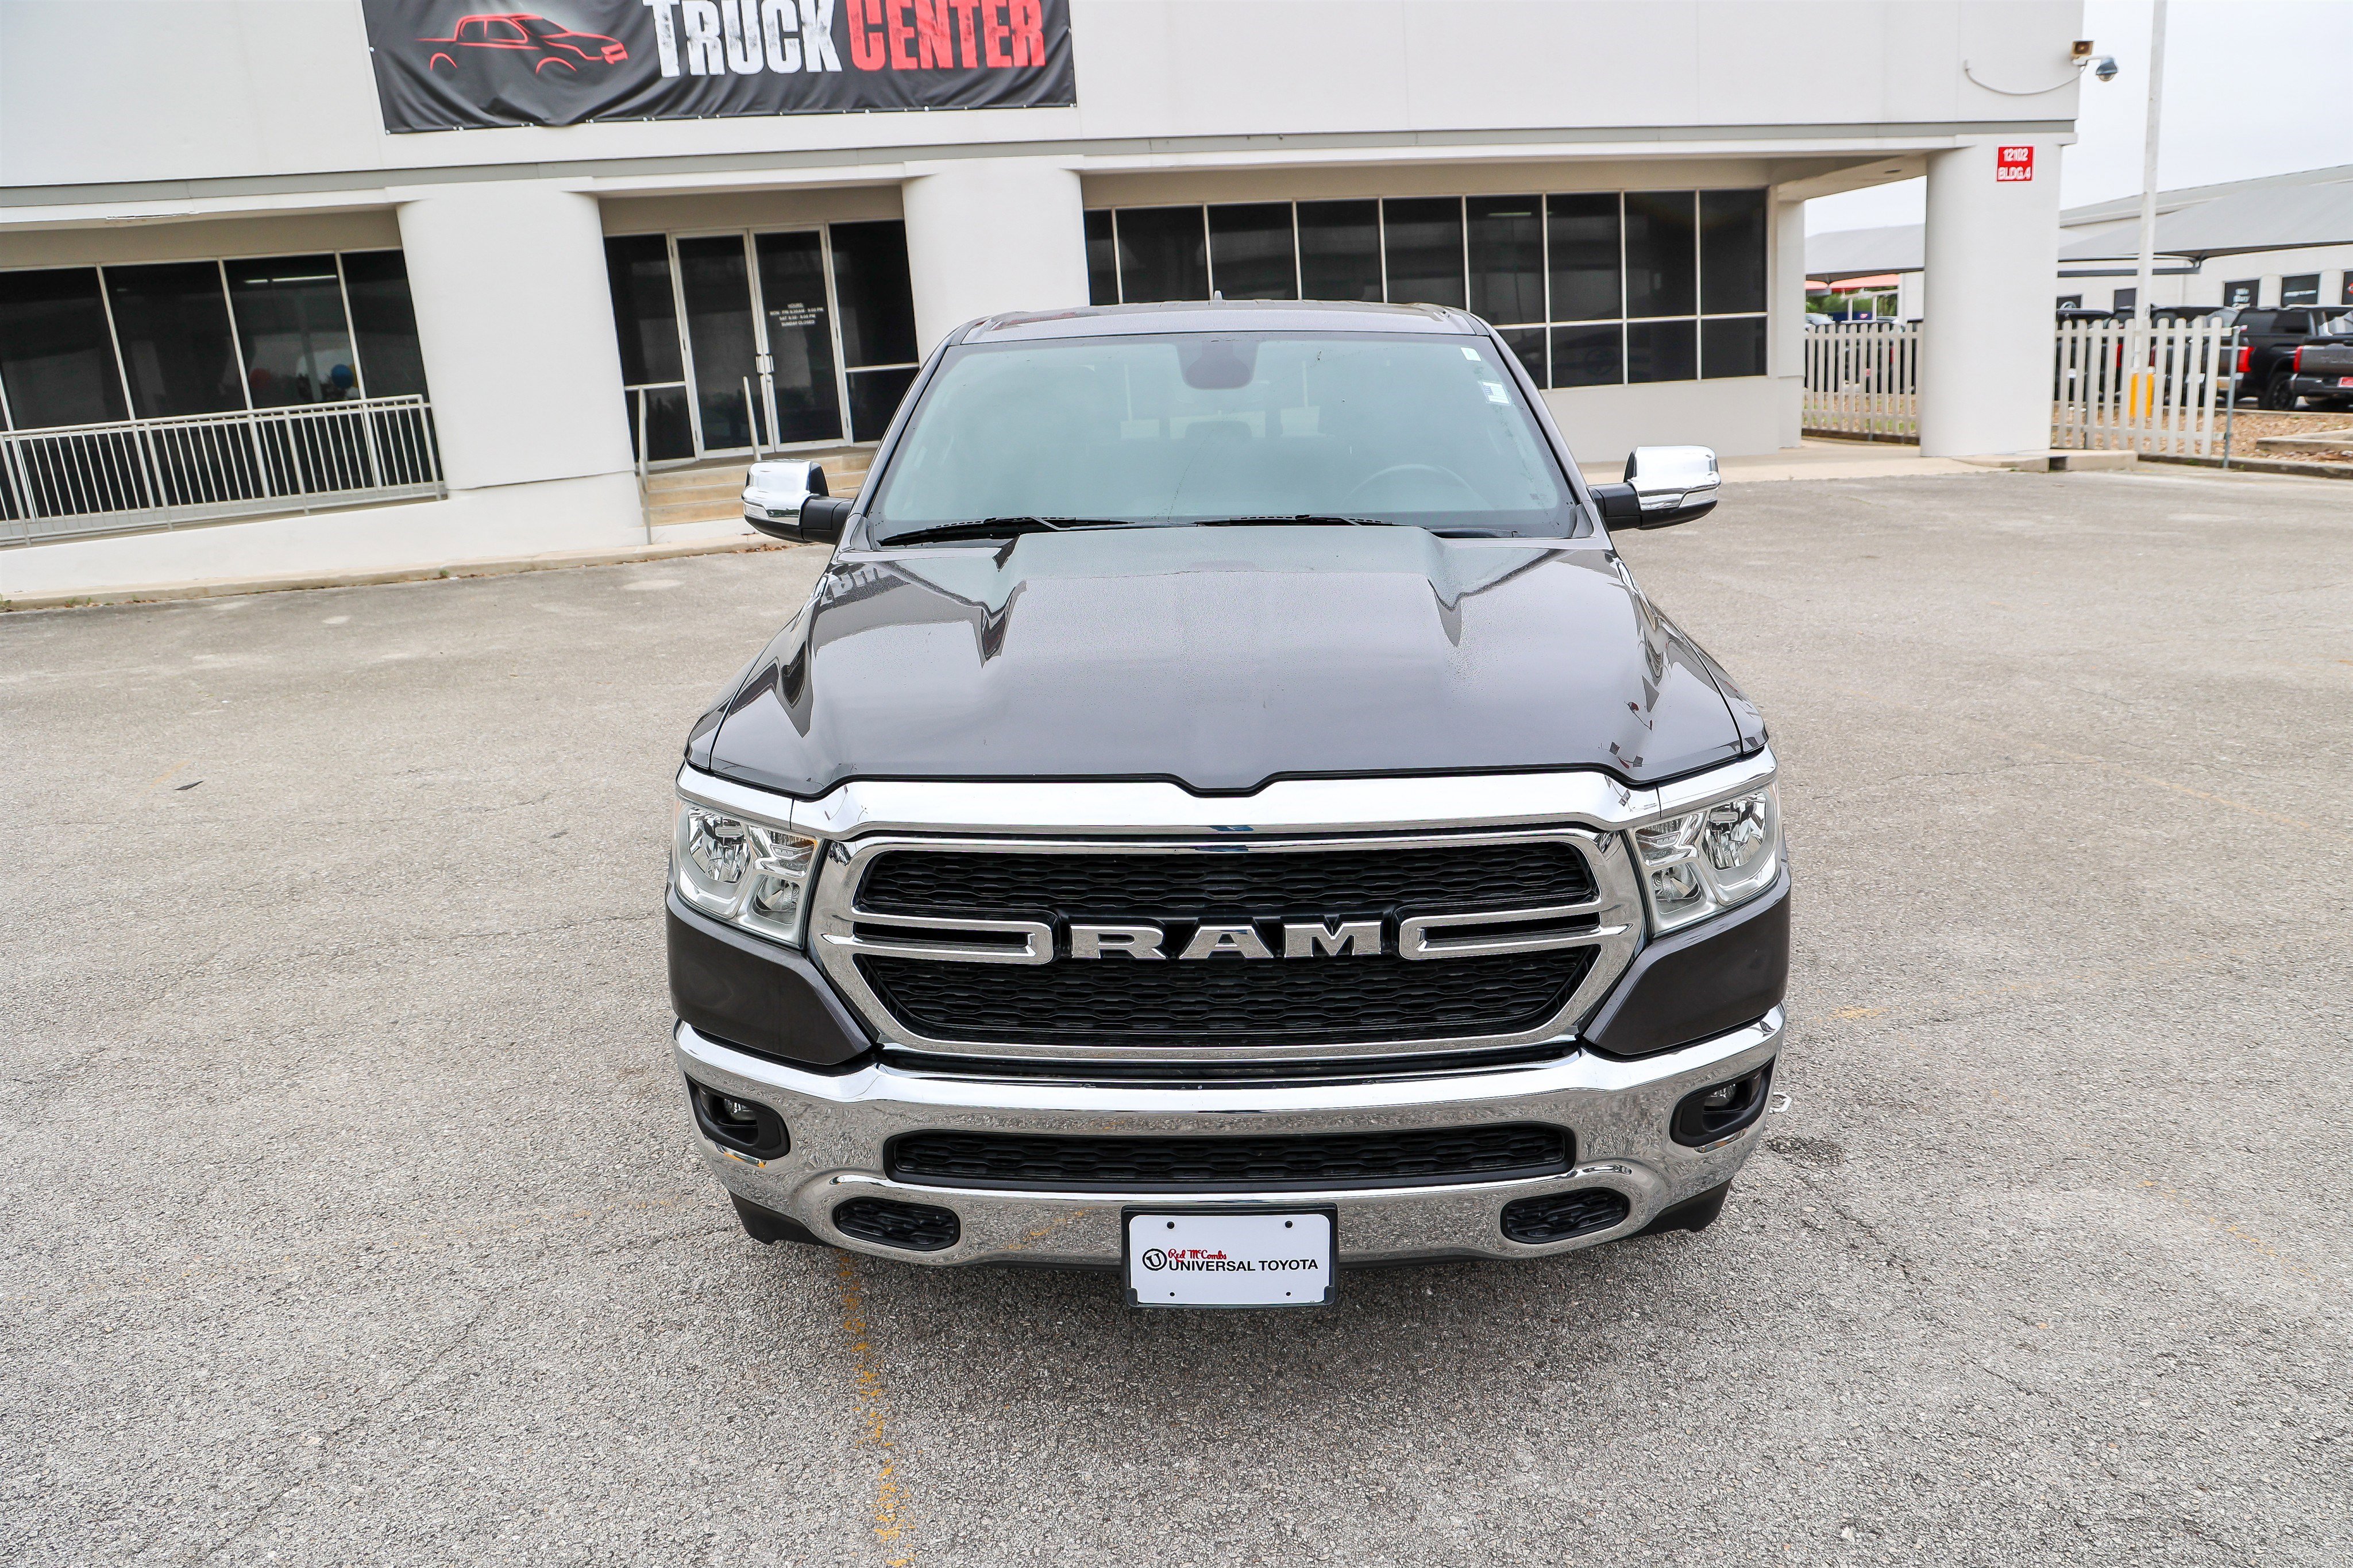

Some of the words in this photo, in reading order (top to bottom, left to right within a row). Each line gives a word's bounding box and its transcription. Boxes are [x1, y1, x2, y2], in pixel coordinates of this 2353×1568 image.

[642, 0, 843, 78] TRUCK
[846, 0, 1046, 71] CENTER
[2003, 148, 2028, 162] 12102
[1070, 920, 1383, 960] RAM
[1168, 1248, 1186, 1262] Red
[1187, 1249, 1227, 1260] McCombs
[1168, 1260, 1256, 1272] UNIVERSAL
[1258, 1259, 1319, 1271] TOYOTA
